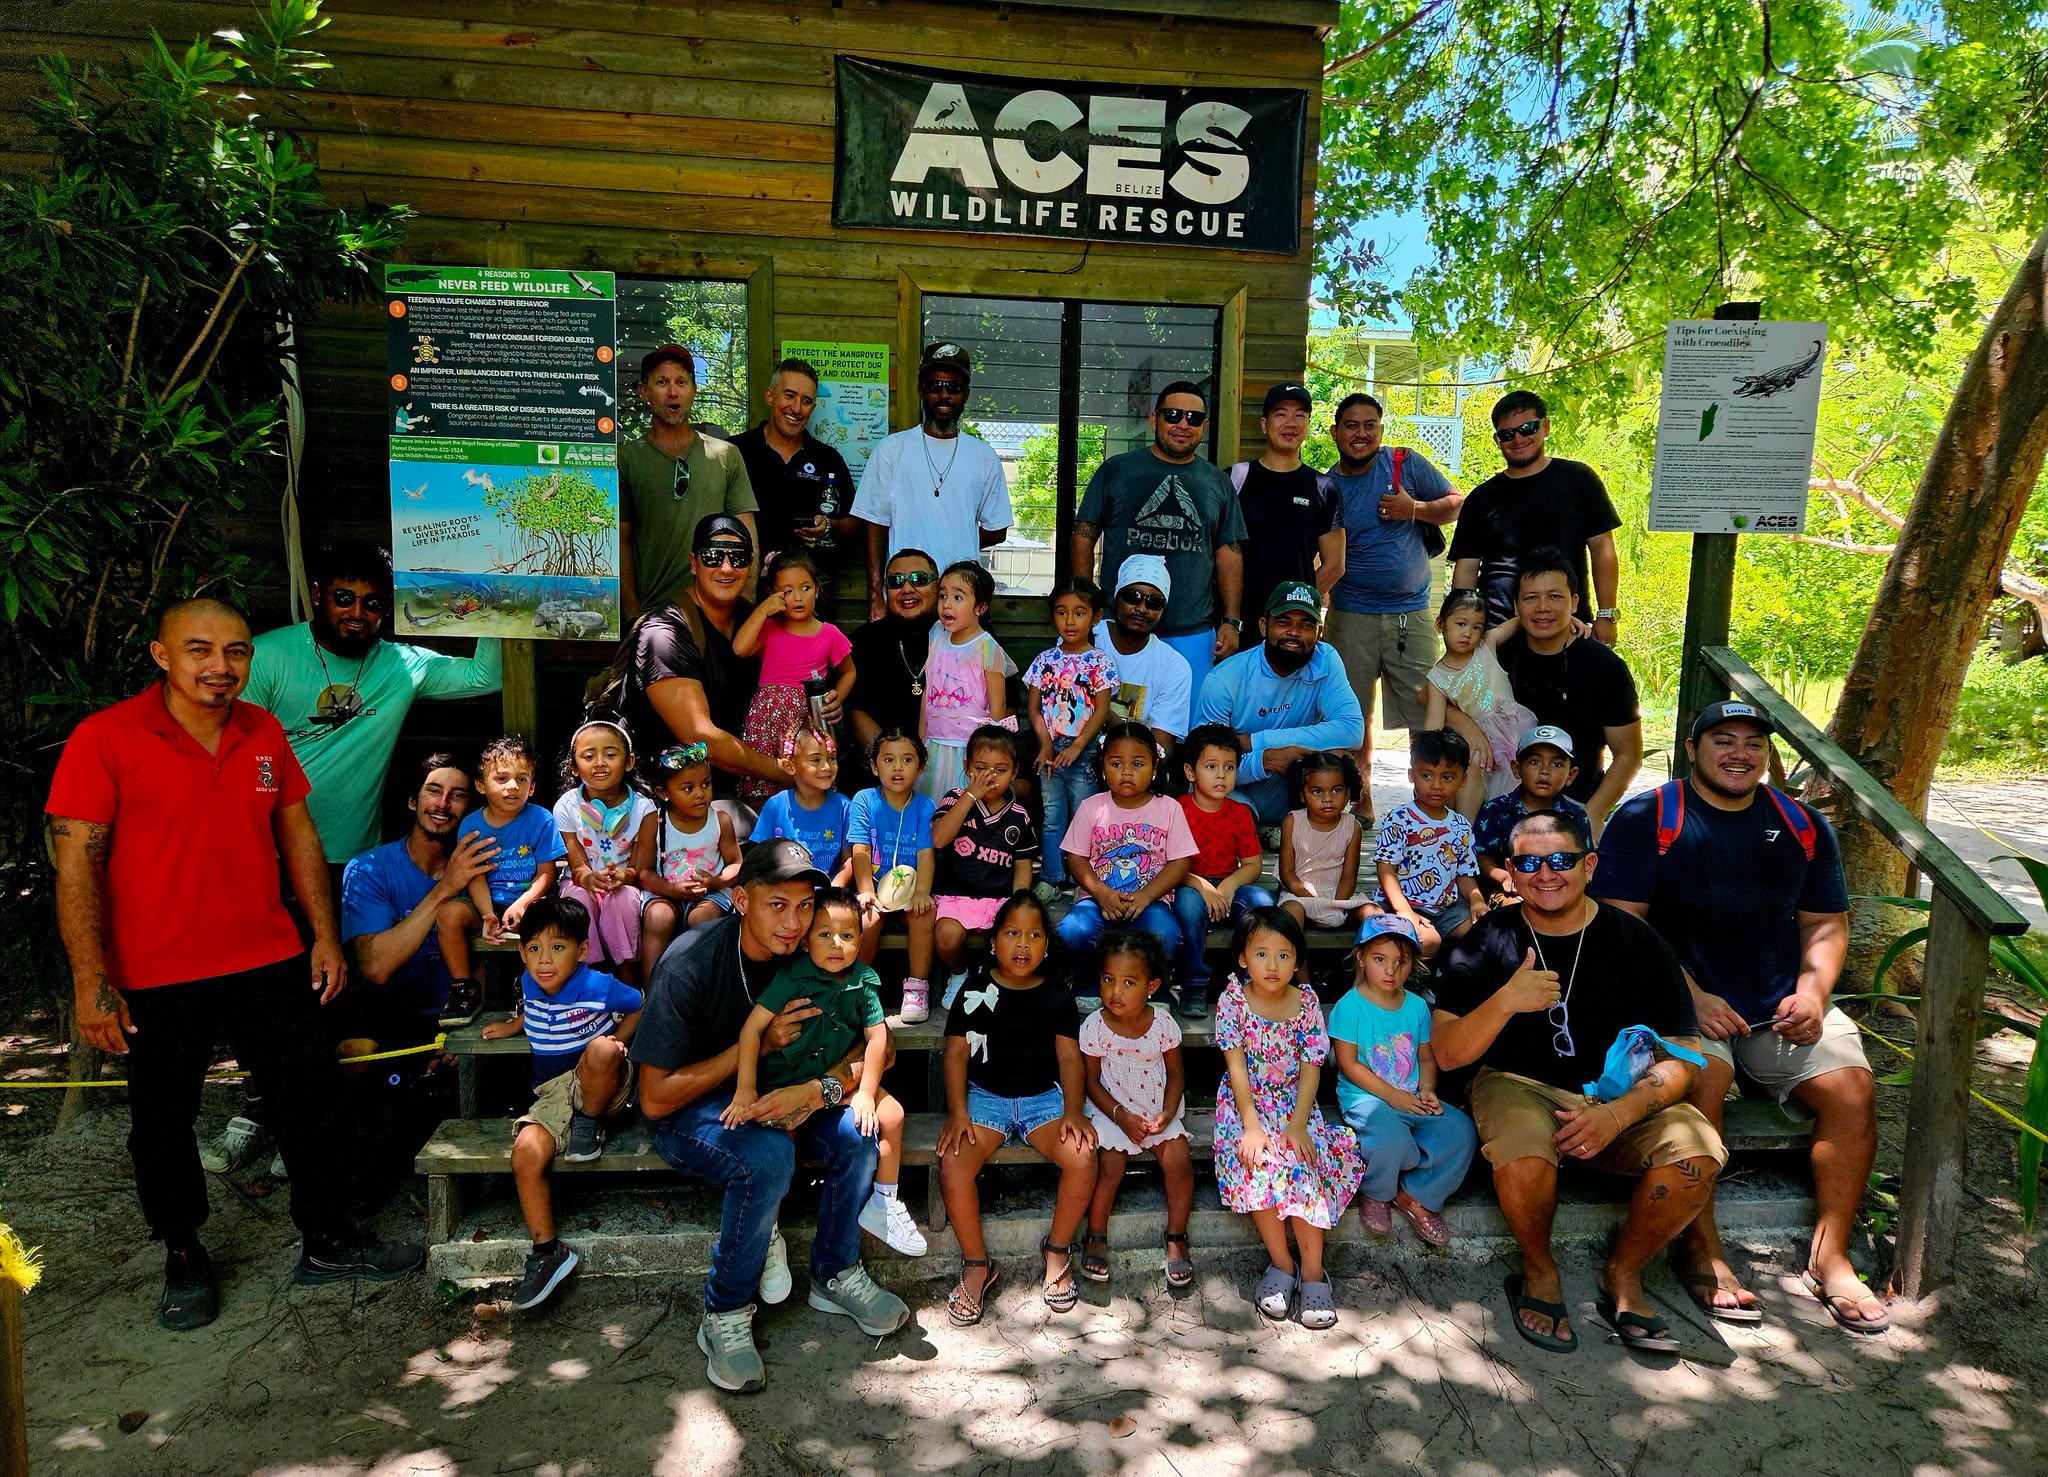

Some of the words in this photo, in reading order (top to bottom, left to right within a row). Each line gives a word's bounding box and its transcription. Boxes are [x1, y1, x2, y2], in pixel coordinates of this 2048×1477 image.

[890, 82, 1254, 204] ACES
[1116, 184, 1162, 196] BELIZE
[890, 190, 1078, 228] WILDLIFE
[1099, 205, 1245, 238] RESCUE
[439, 280, 477, 290] NEVER
[481, 281, 509, 291] FEED
[513, 282, 569, 293] WILDLIFE
[516, 300, 549, 308] BEHAVIOR
[502, 309, 522, 317] people
[543, 310, 559, 318] being
[1674, 326, 1696, 336] Tips
[1698, 326, 1712, 335] for
[1715, 326, 1768, 338] Coexisting
[486, 333, 501, 341] MAY
[501, 334, 535, 342] CONSUME
[535, 335, 564, 343] FOREIGN
[565, 336, 595, 344] OBJECTS
[1674, 338, 1696, 346] with
[1698, 338, 1750, 347] Crocodiles
[602, 351, 607, 359] 2
[787, 348, 820, 357] PROTECT
[840, 350, 884, 359] MANGROVES
[832, 360, 865, 368] PROTECT
[420, 368, 456, 376] IMPROPER,
[456, 369, 499, 377] UNBALANCED
[841, 370, 880, 379] COASTLINE
[464, 404, 494, 412] GREATER
[510, 405, 519, 413] OF
[520, 406, 546, 414] DISEASE
[547, 406, 595, 415] TRANSMISSION
[548, 430, 568, 438] people
[565, 446, 616, 462] ACES
[402, 521, 447, 534] REVEALING
[450, 515, 481, 526] ROOTS:
[1756, 516, 1798, 527] ACES
[412, 539, 428, 547] LIFE
[441, 529, 480, 541] PARADISE
[416, 526, 457, 539] DIVERSITY
[1127, 528, 1202, 552] Reebok
